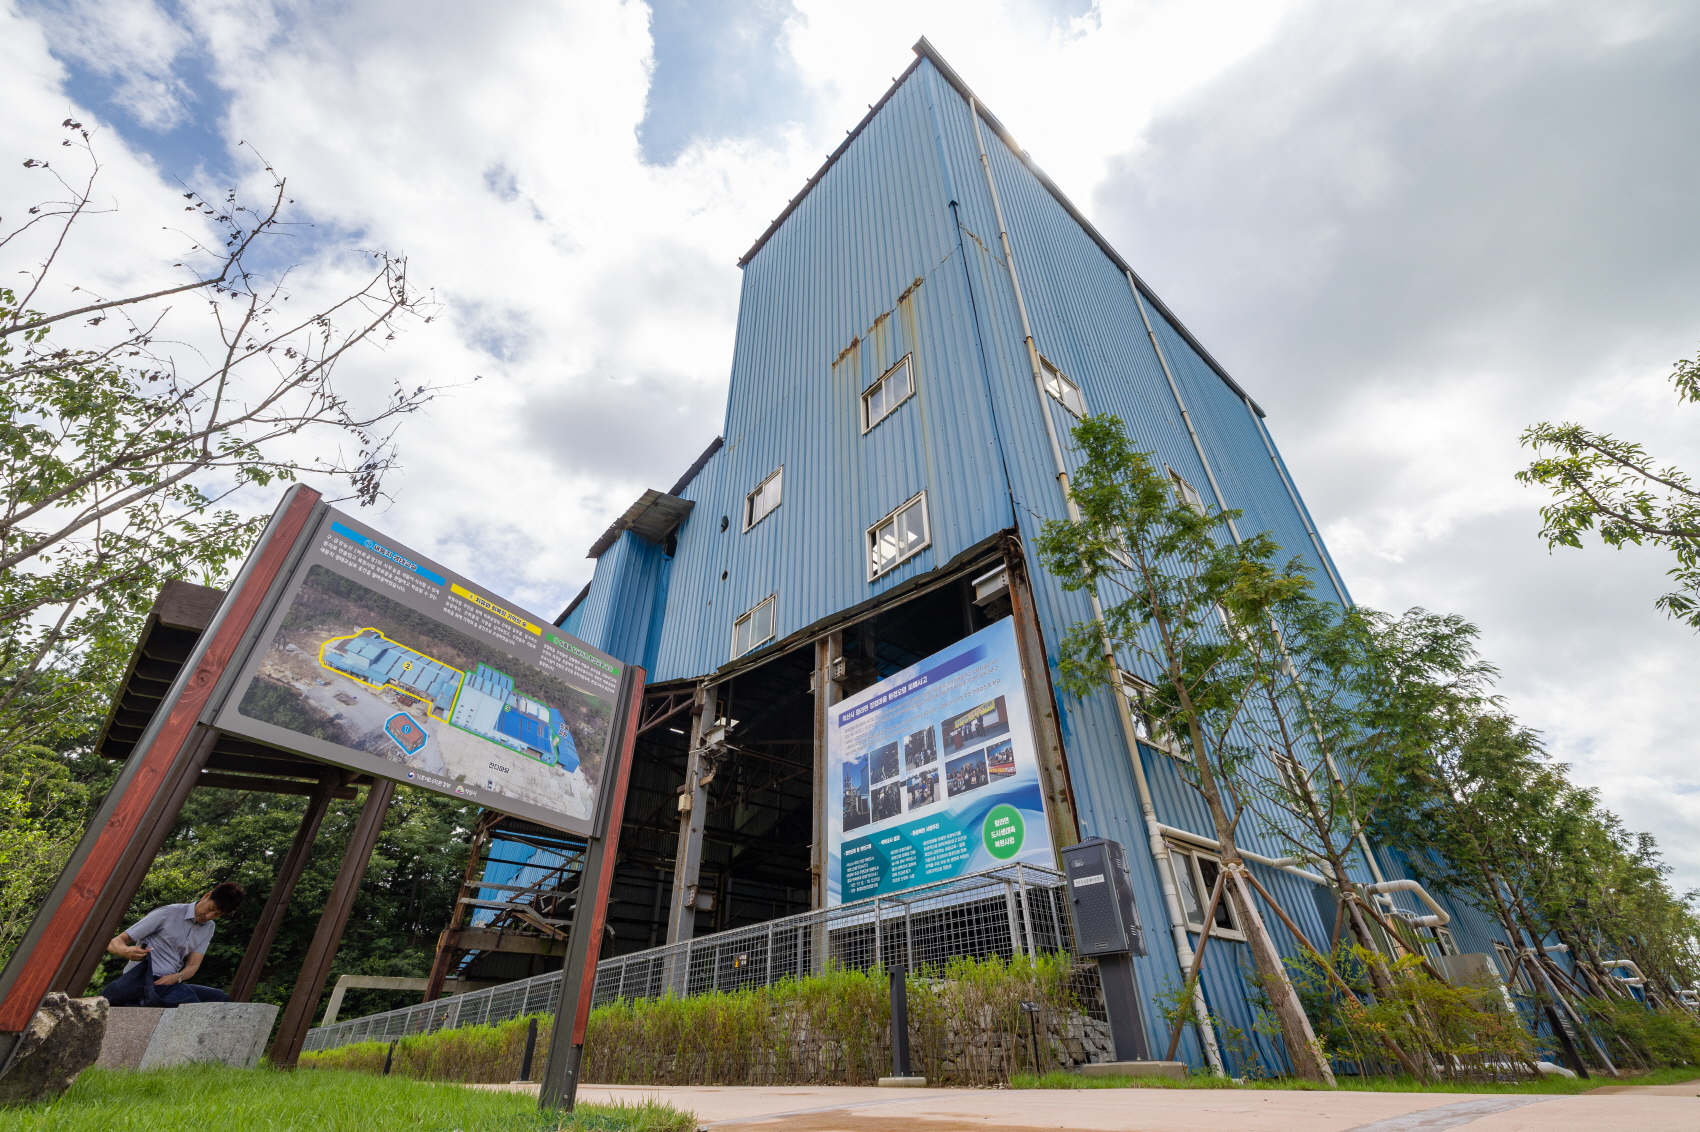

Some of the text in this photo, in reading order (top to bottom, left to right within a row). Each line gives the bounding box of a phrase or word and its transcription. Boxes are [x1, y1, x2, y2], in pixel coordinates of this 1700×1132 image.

[393, 555, 418, 571] 생태교실
[488, 762, 510, 774] 잔디마당
[994, 837, 1015, 847] 복원사업
